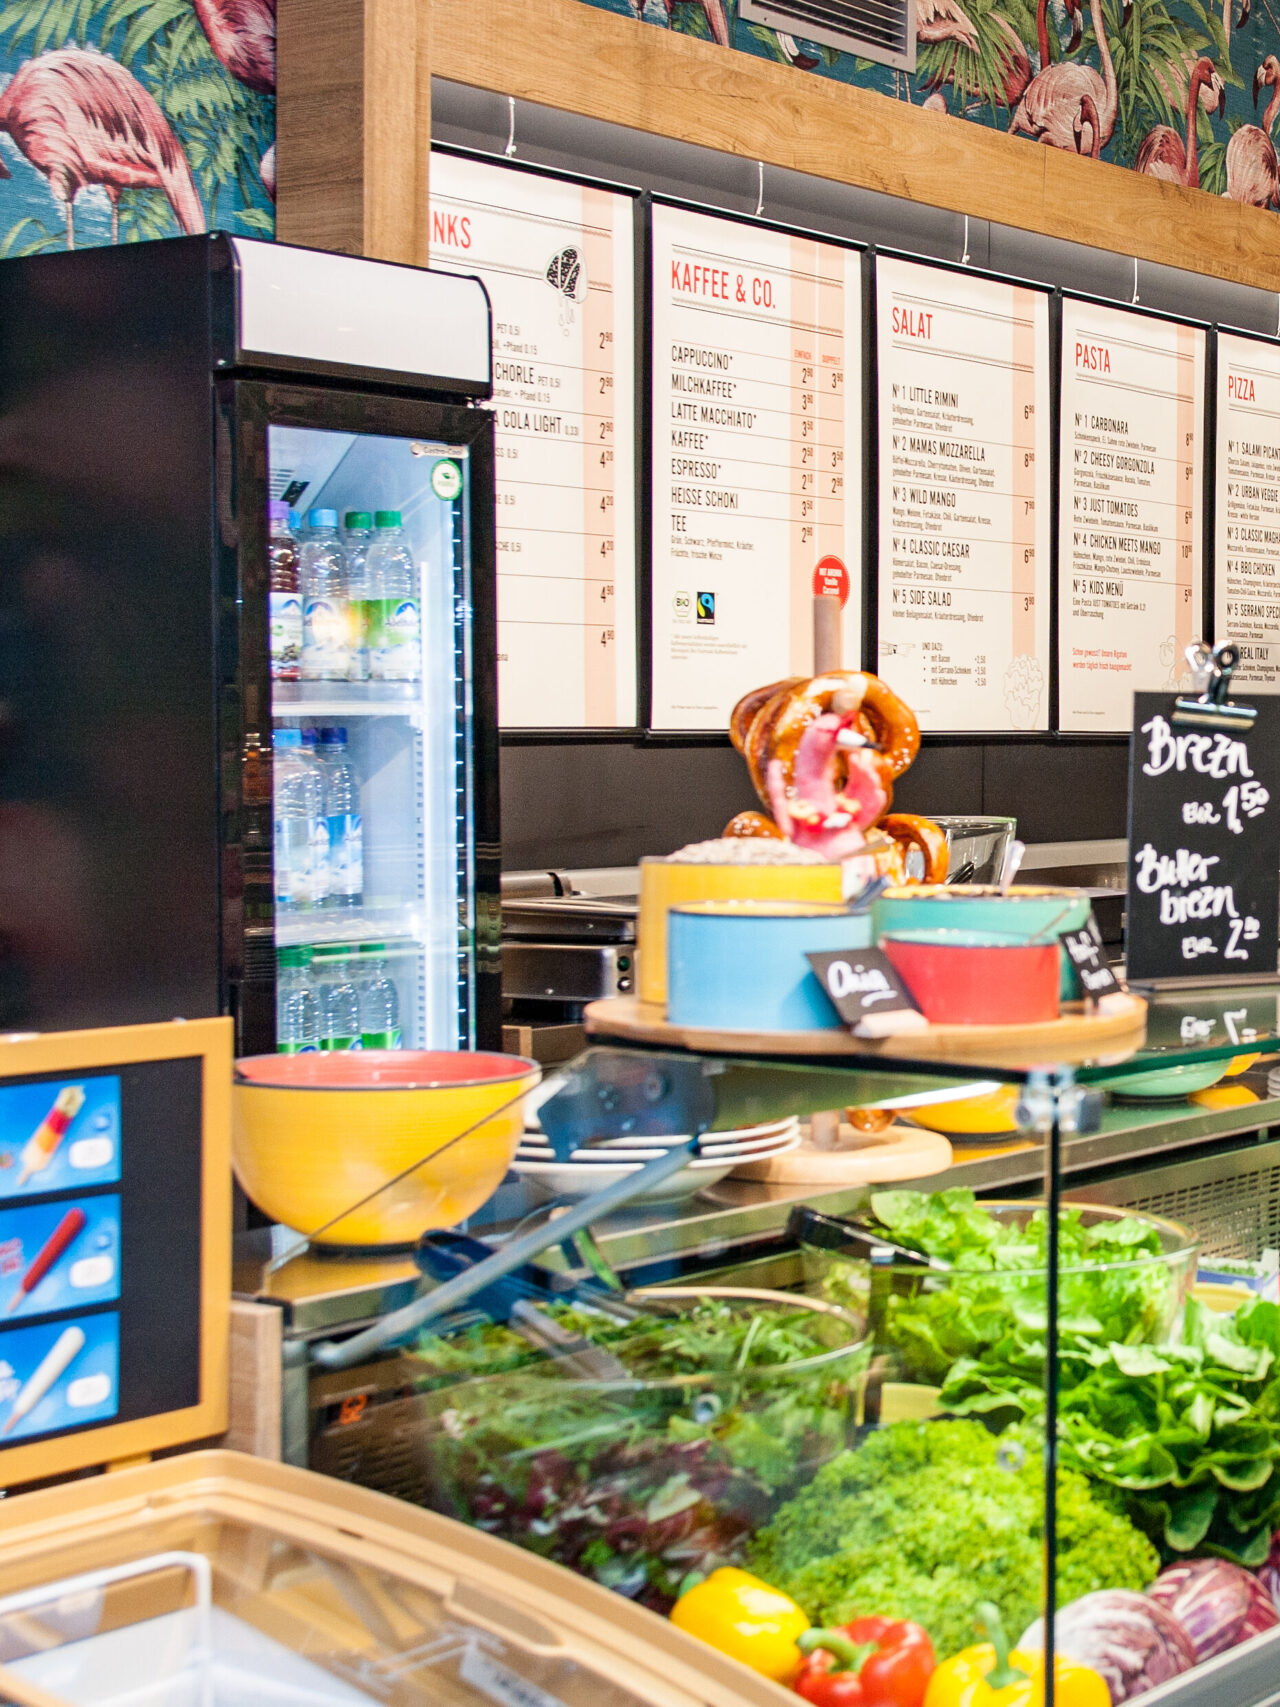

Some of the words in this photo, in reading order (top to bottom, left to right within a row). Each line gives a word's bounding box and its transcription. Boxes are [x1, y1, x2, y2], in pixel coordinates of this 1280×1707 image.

[671, 260, 729, 300] KAFFEE
[736, 274, 746, 303] &
[753, 277, 776, 309] CO.
[892, 307, 933, 339] SALAT
[1075, 343, 1111, 373] PASTA
[910, 387, 932, 404] LITTLE
[935, 391, 959, 408] RIMINI
[1228, 375, 1255, 401] PIZZA
[671, 401, 698, 421] LATTE
[503, 411, 530, 431] COLA
[533, 415, 562, 435] LIGHT
[1091, 415, 1128, 435] CARBONARA
[902, 436, 906, 451] 2
[910, 437, 937, 455] MAMAS
[939, 442, 985, 462] MOZZARELLA
[1242, 442, 1261, 457] SALAMI
[1083, 451, 1087, 464] 2
[1091, 452, 1114, 469] CHEESY
[1116, 456, 1155, 475] GORGONZOLA
[671, 487, 702, 506] HEISSE
[706, 490, 738, 509] SCHOKI
[902, 487, 907, 503] 3
[909, 488, 927, 505] WILD
[930, 491, 956, 508] MANGO
[1242, 485, 1260, 500] URBAN
[1261, 488, 1278, 502] VEGGIE
[1083, 498, 1087, 510] 3
[1090, 499, 1105, 513] JUST
[1107, 501, 1138, 517] TOMATOES
[671, 514, 687, 532] TEE
[1082, 533, 1087, 546] 4
[1090, 534, 1117, 550] CHICKEN
[1119, 538, 1138, 553] MEETS
[1140, 540, 1161, 555] MANGO
[1241, 527, 1263, 543] CLASSIC
[902, 539, 907, 554] 4
[909, 539, 939, 556] CLASSIC
[942, 542, 970, 559] CAESAR
[1241, 561, 1252, 575] BBQ
[1253, 562, 1275, 576] CHICKEN
[902, 589, 907, 605] 5
[909, 590, 925, 606] SIDE
[928, 592, 951, 607] SALAD
[1082, 581, 1086, 593] 5
[1090, 581, 1104, 595] KIDS
[1106, 581, 1123, 597] MENÜ
[1240, 604, 1264, 619] SERRANO
[1240, 648, 1254, 660] REAL
[1255, 648, 1269, 660] ITALY
[1141, 715, 1254, 778] Brezn
